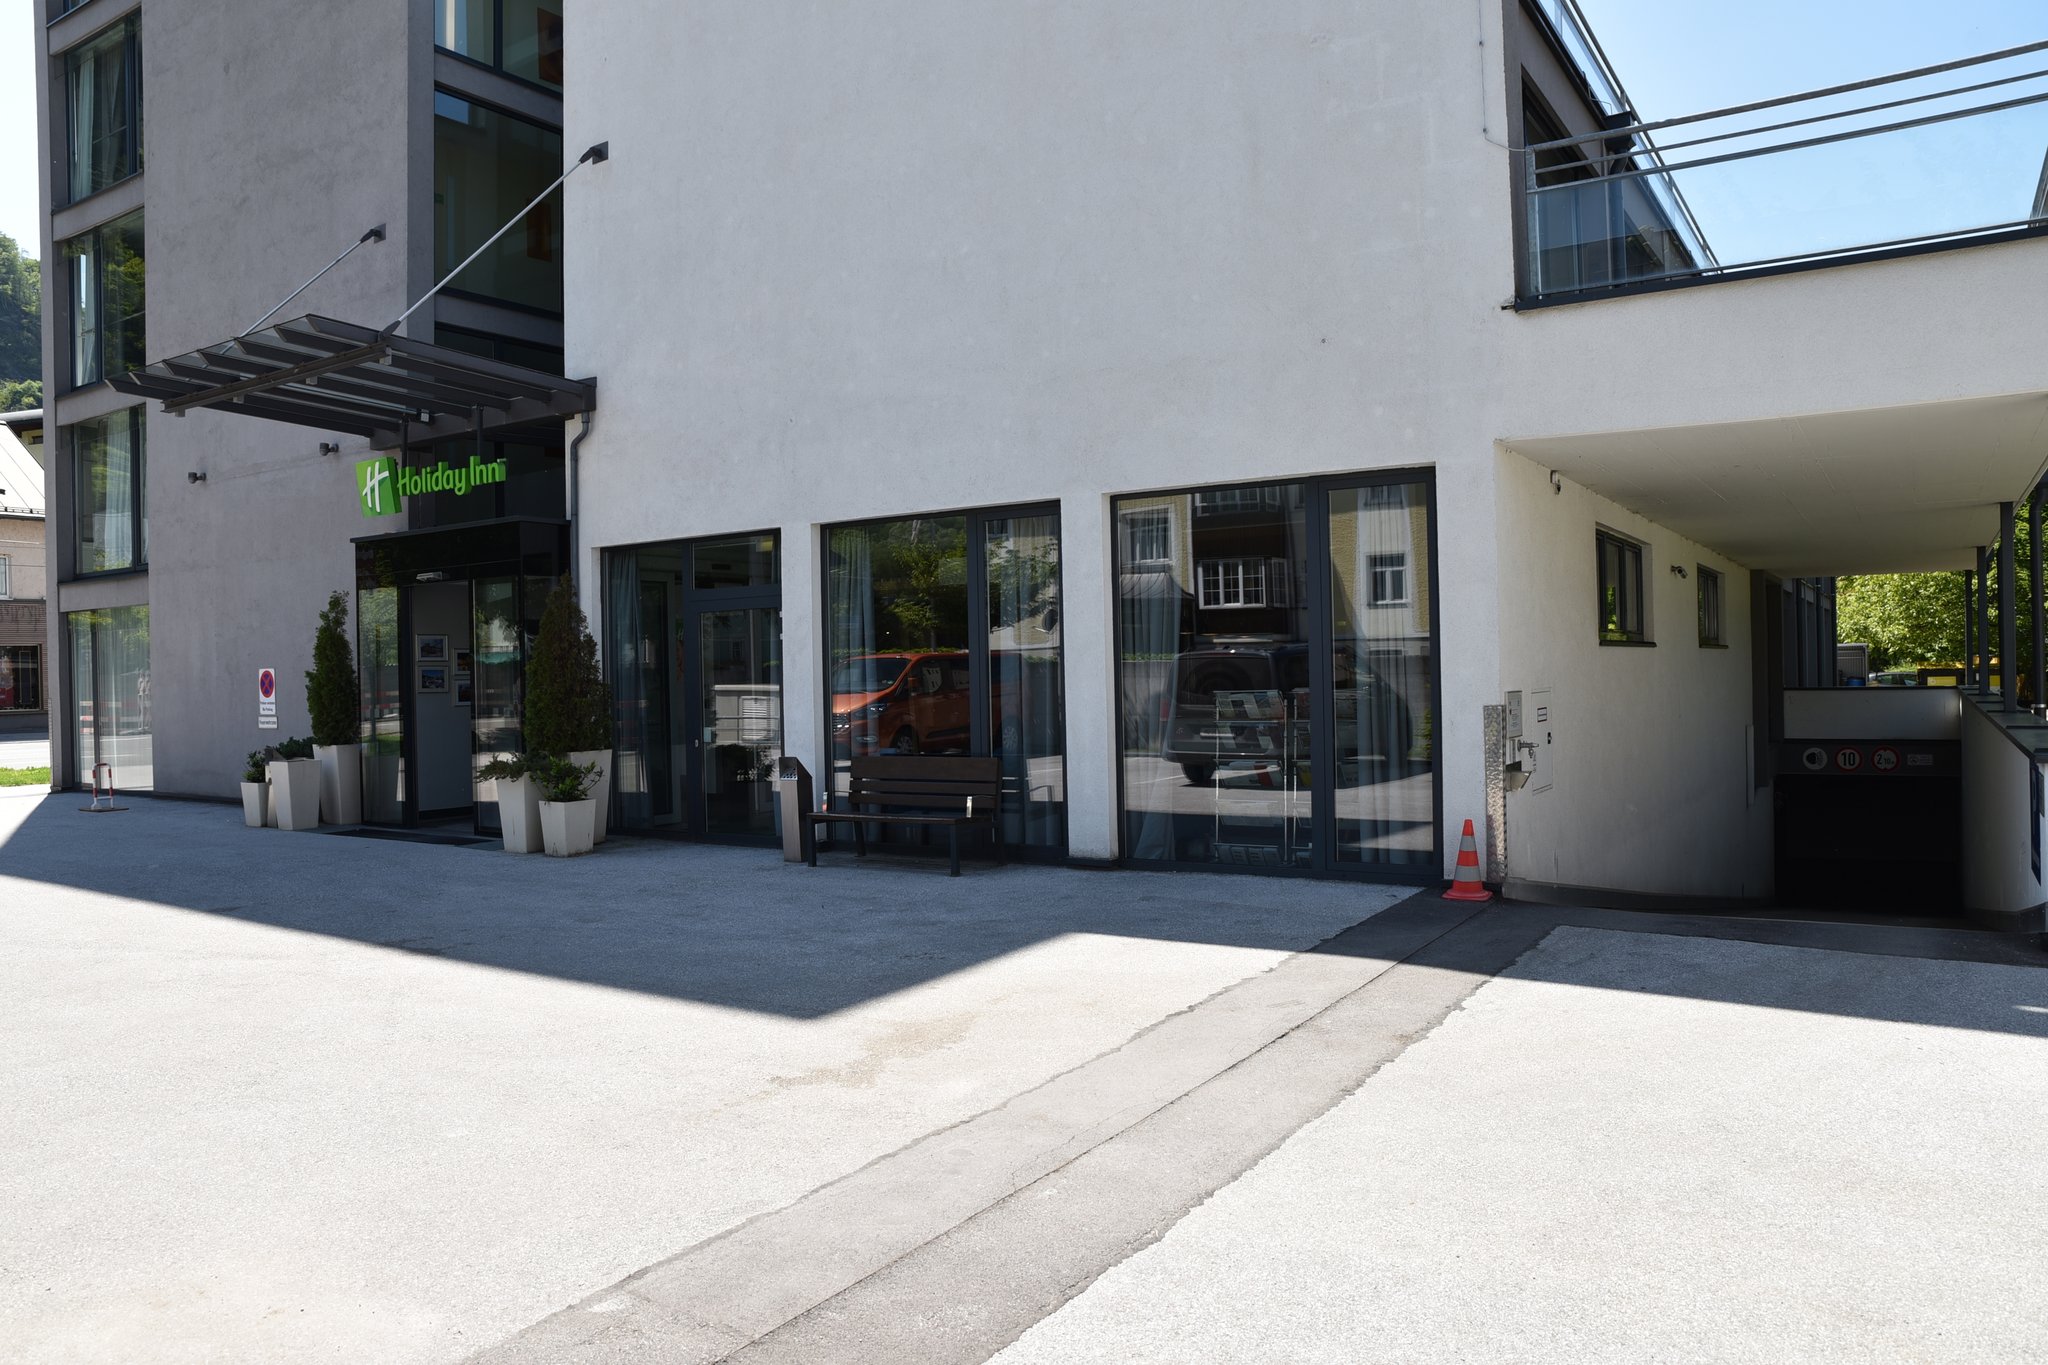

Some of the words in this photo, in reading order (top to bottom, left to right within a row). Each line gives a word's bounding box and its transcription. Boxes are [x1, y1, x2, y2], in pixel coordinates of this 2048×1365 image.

[397, 461, 466, 496] Holiday
[470, 455, 503, 487] Inn
[1841, 752, 1855, 766] 10
